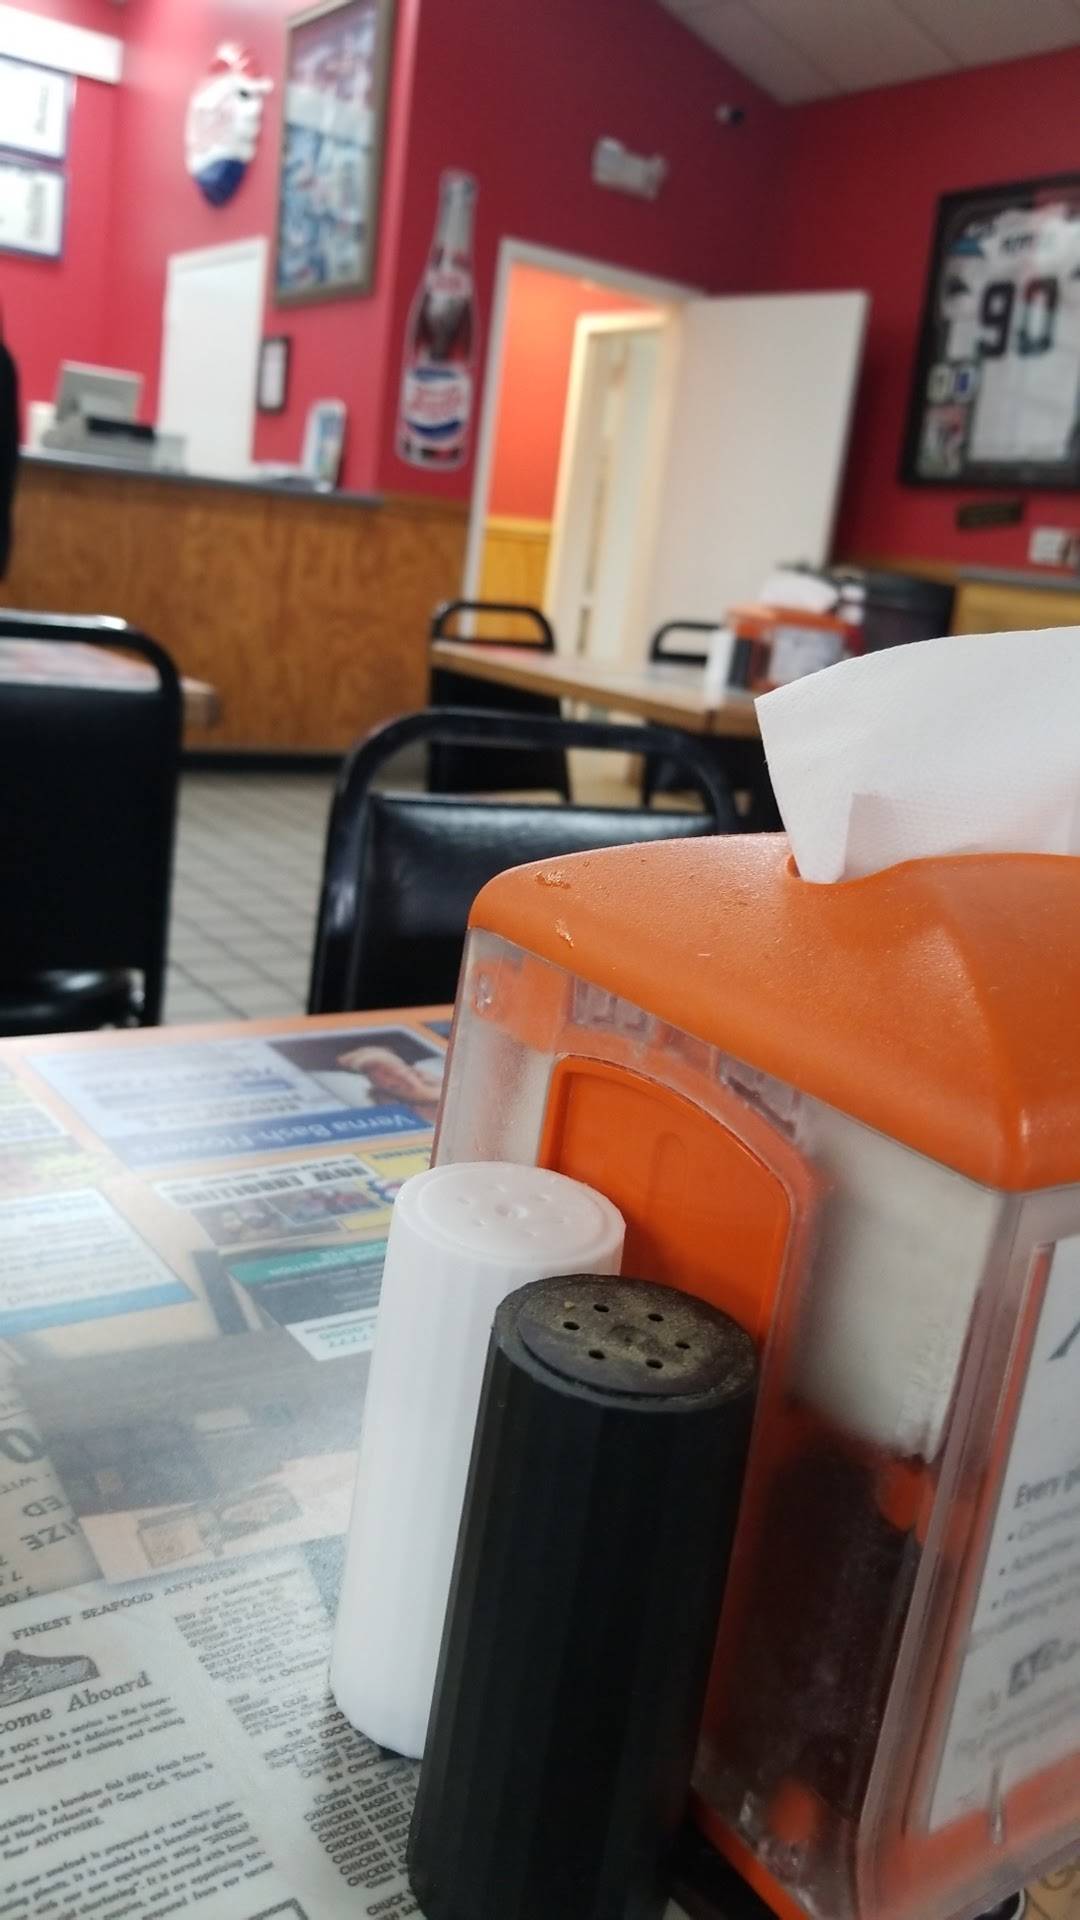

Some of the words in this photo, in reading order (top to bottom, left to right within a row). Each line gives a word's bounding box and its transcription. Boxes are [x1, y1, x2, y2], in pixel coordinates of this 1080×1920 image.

[976, 276, 1059, 357] 90
[12, 1615, 72, 1640] FINEST
[81, 1592, 154, 1620] SEAFOOD
[67, 1670, 153, 1713] Aboard
[116, 1788, 144, 1802] Cape
[304, 1797, 352, 1823] CHICKEN
[352, 1781, 391, 1802] BASKET
[310, 1807, 359, 1832] CHICKEN
[360, 1790, 399, 1812] BASKET
[317, 1818, 366, 1844] CHICKEN
[366, 1801, 406, 1823] BASKET
[325, 1828, 374, 1854] CHICKEN
[374, 1810, 412, 1833] BASKET
[332, 1838, 382, 1865] CHICKEN
[339, 1850, 389, 1876] CHICKEN
[347, 1859, 398, 1887] CHICKEN
